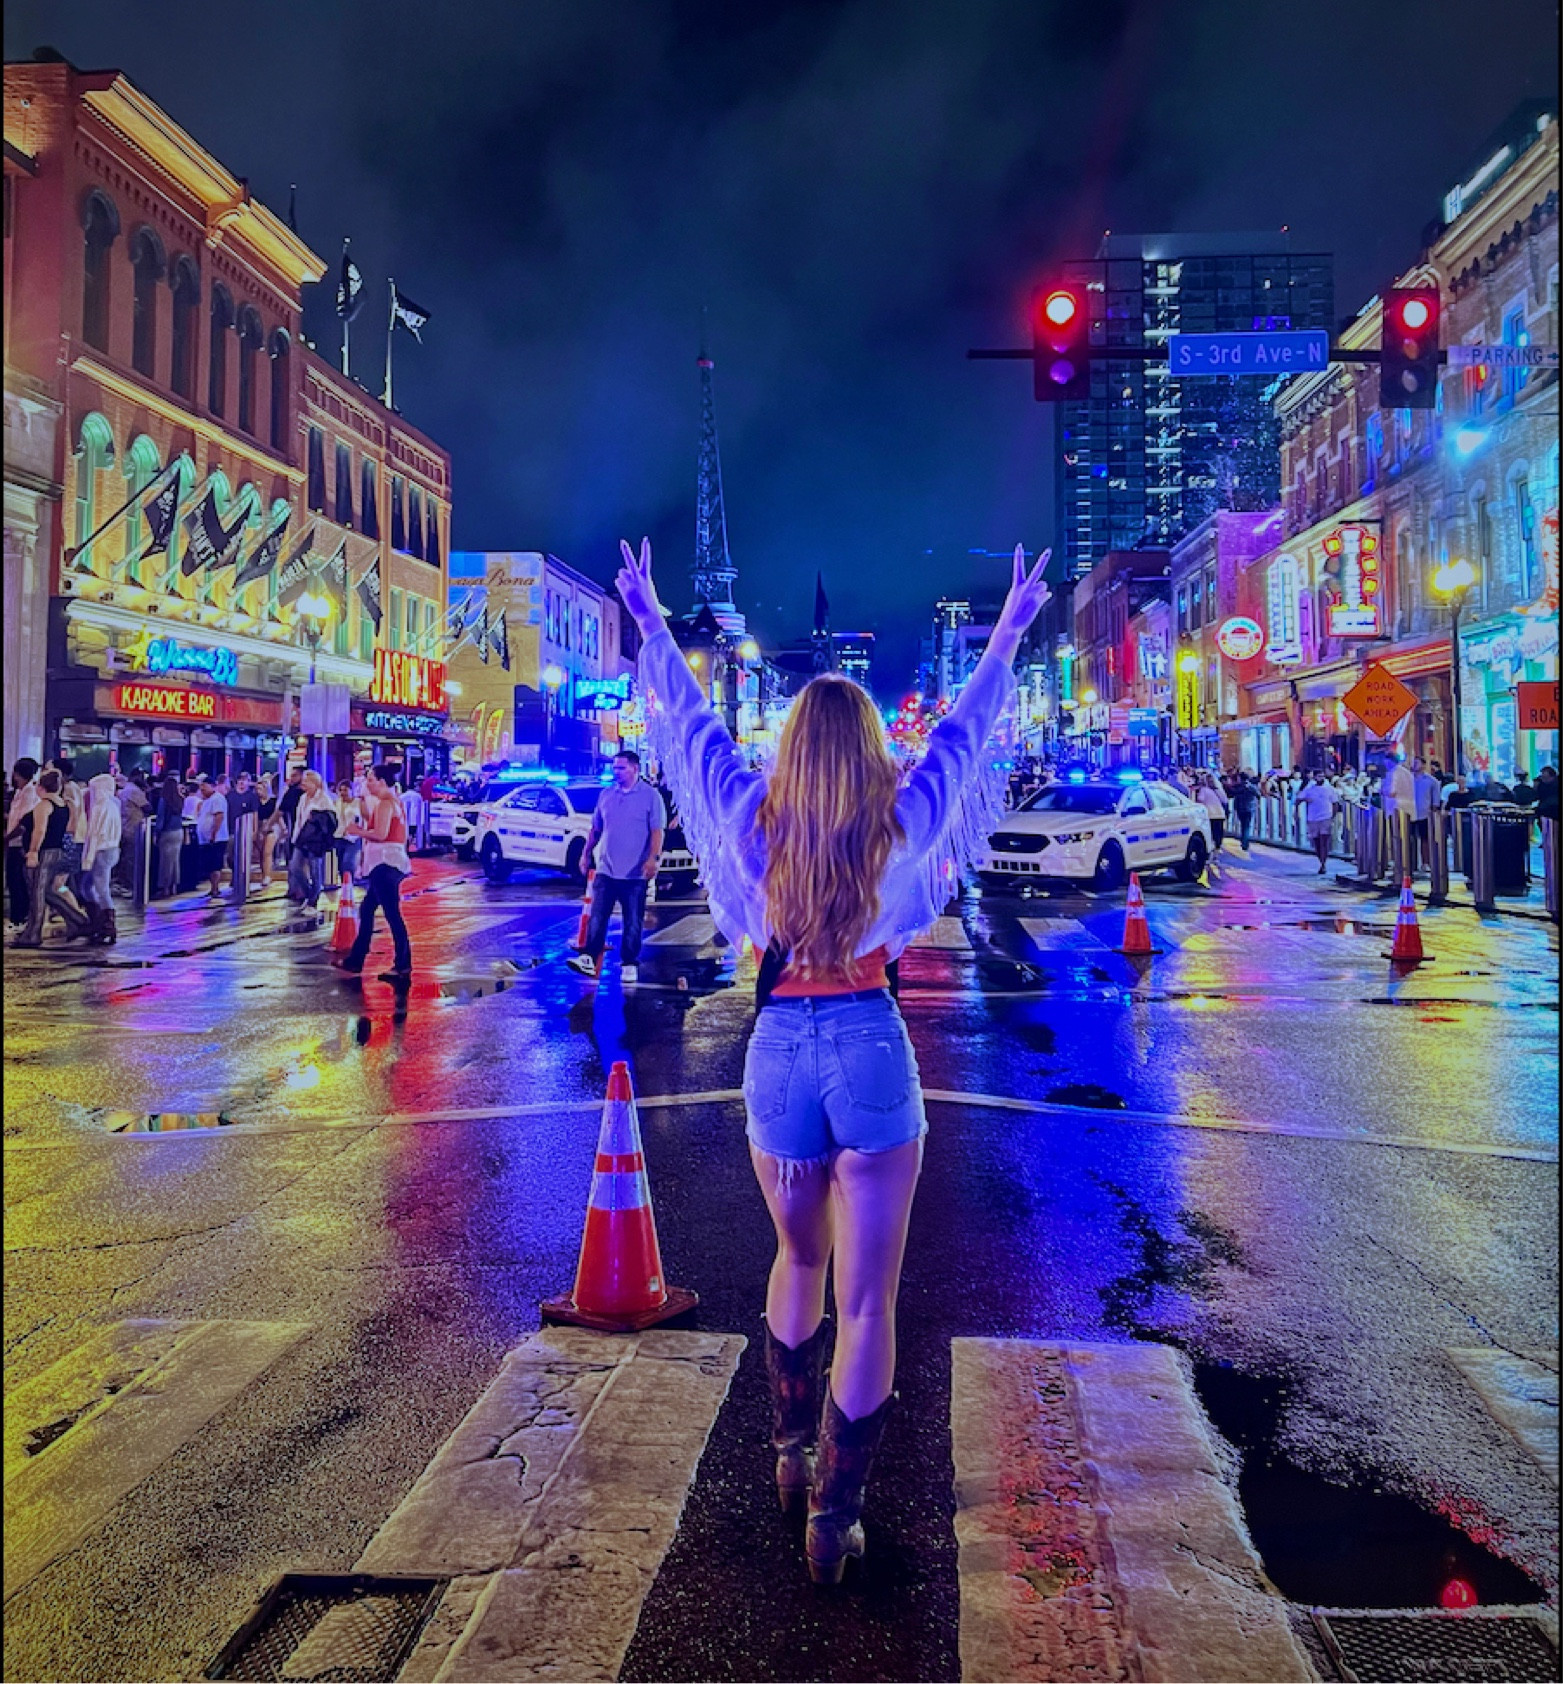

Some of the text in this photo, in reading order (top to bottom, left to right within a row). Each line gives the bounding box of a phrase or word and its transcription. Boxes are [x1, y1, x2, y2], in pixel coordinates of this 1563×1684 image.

[1472, 347, 1543, 364] PARKING
[1366, 681, 1395, 692] ROAD
[120, 684, 215, 717] KARAOKE BAR
[1366, 695, 1396, 705] WORK
[1364, 708, 1399, 718] AHEAD
